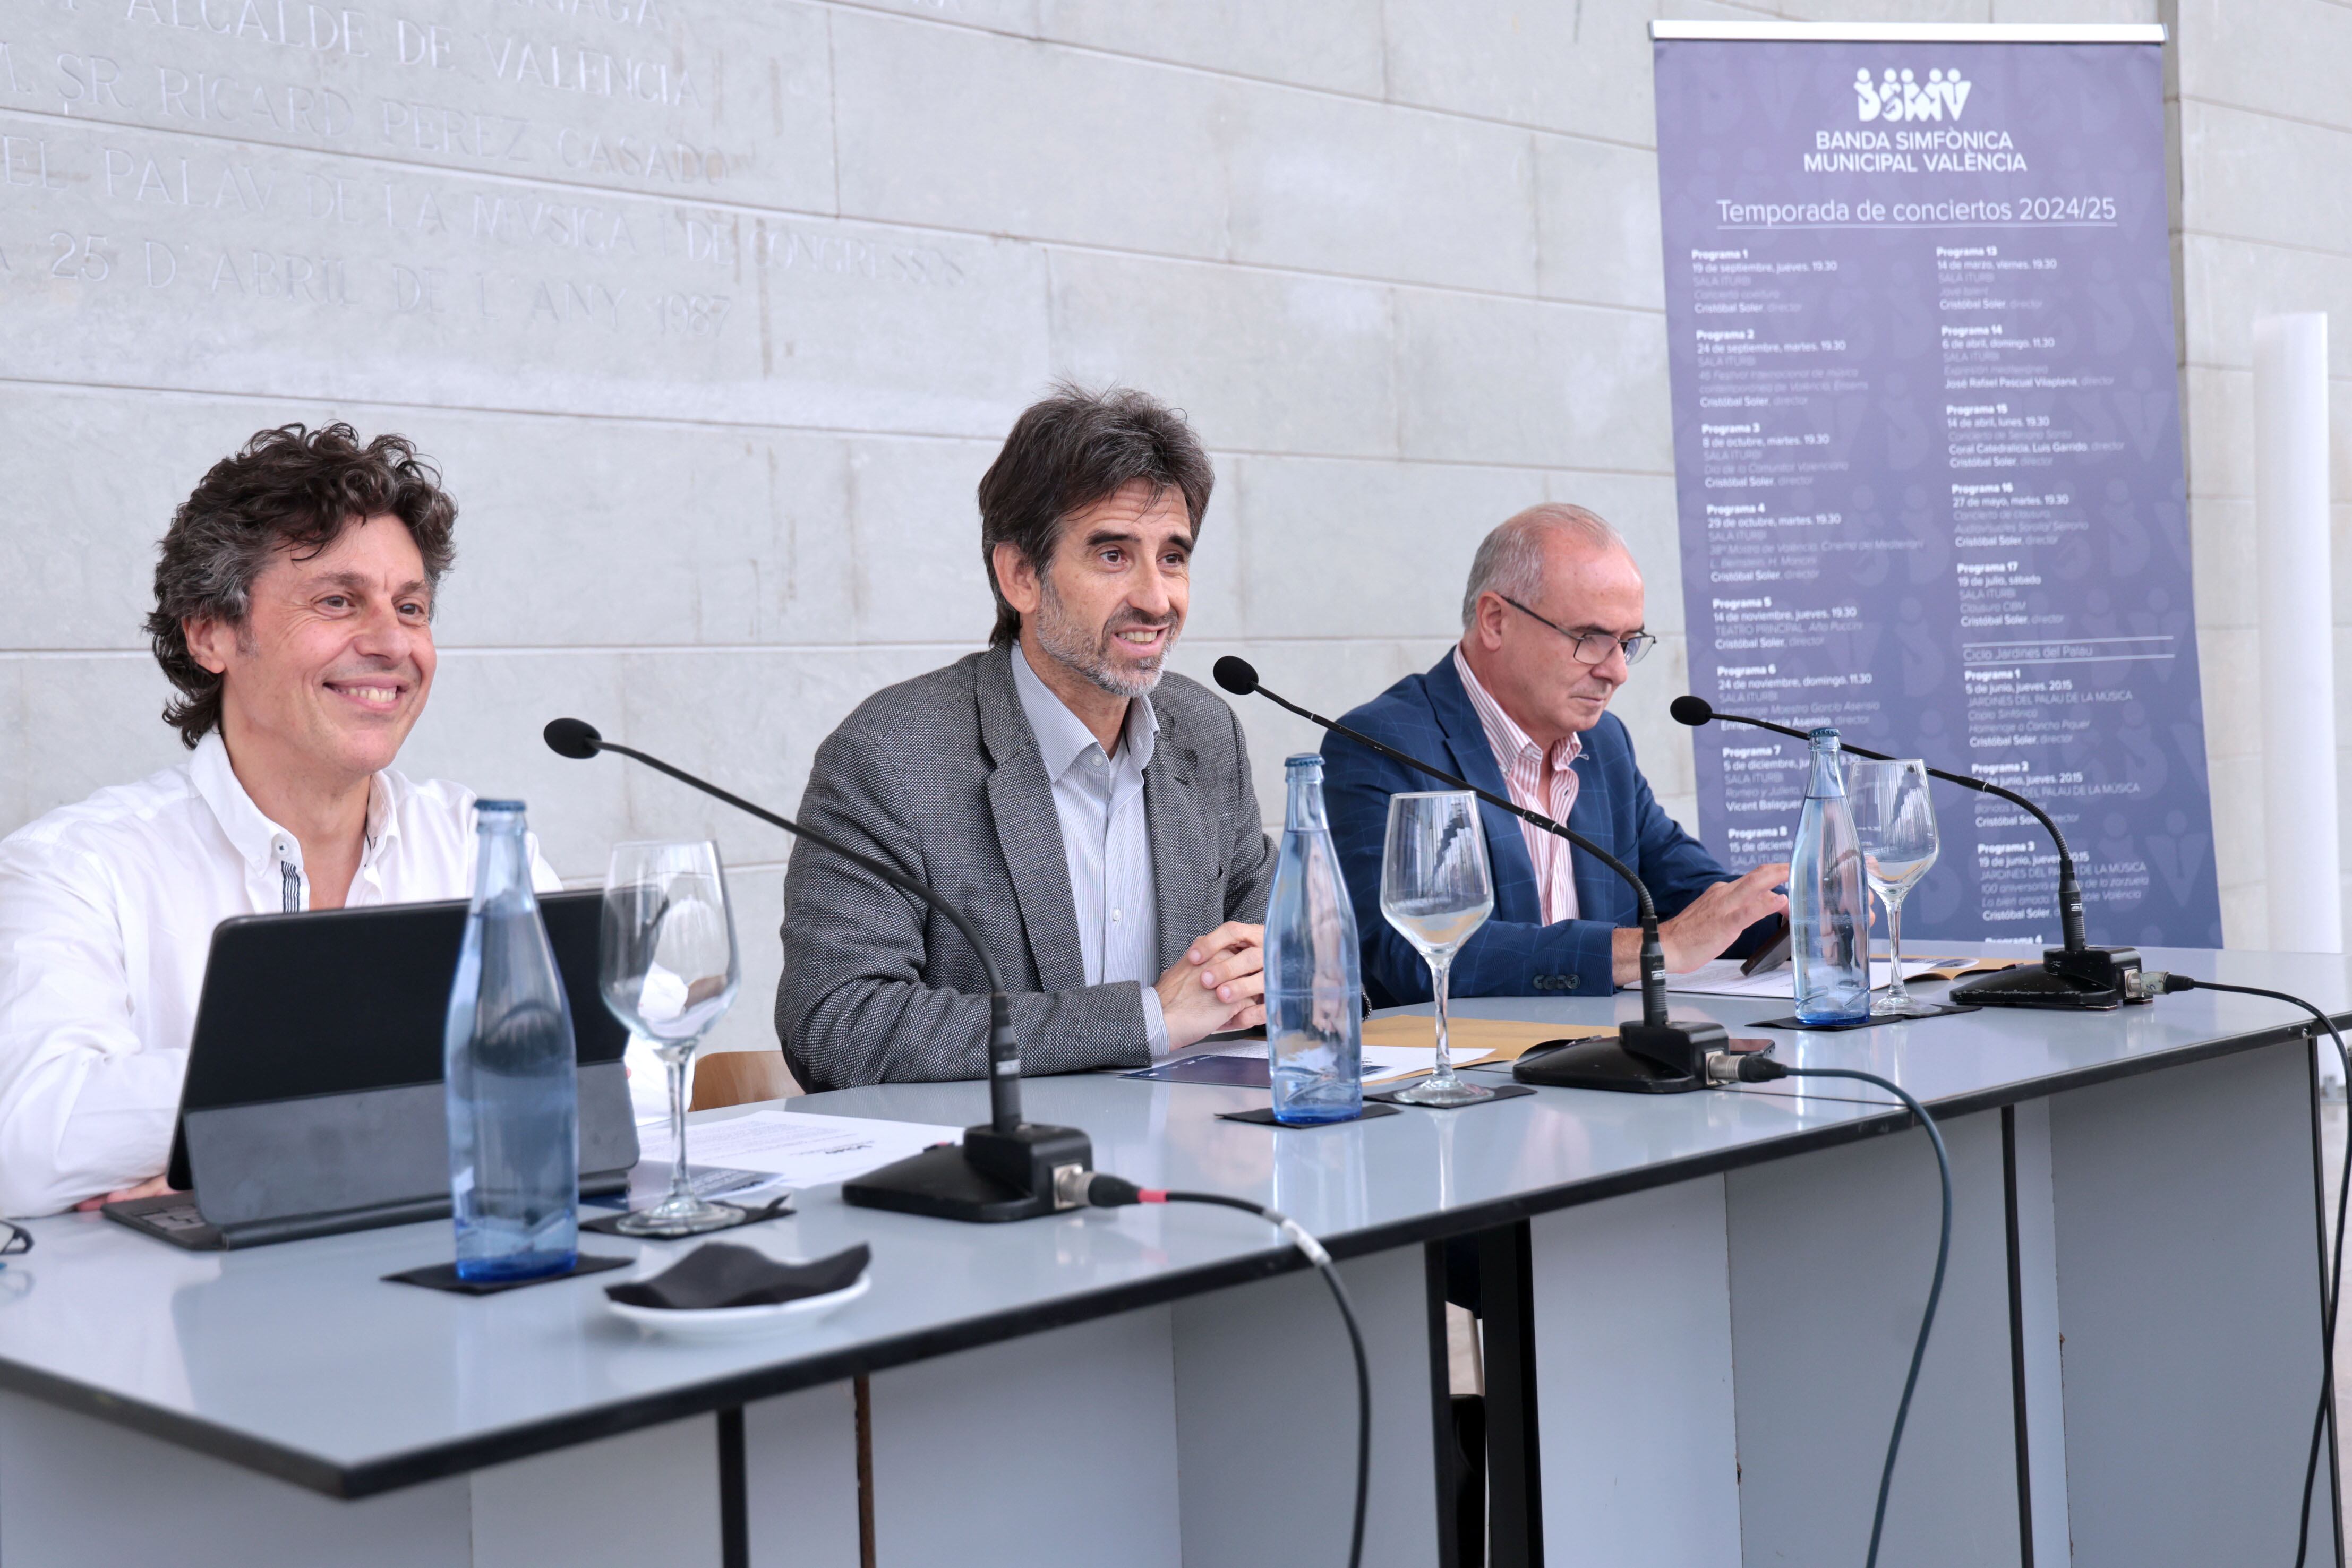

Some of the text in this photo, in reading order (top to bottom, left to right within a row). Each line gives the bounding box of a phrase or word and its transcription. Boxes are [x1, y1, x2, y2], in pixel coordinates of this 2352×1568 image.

[124, 0, 370, 58] ALCALDE
[396, 18, 456, 72] DE
[155, 64, 354, 137] RICARD
[378, 97, 532, 162] PEREZ
[557, 128, 730, 187] CASADO
[1816, 126, 2013, 151] BANDA SIMFÒNICA
[1804, 149, 2028, 172] MUNICIPAL VALÈNCIA
[101, 147, 277, 211] PALAV
[305, 174, 361, 225] DE
[383, 181, 449, 232] LA
[686, 220, 736, 267] DE
[750, 230, 965, 287] CONGRESSOS
[1716, 196, 2116, 227] Temporada de conciertos 2024/25
[1691, 249, 1748, 261] Programa 1
[1936, 246, 1997, 258] Programa 13
[1692, 263, 1703, 273] 19
[1721, 263, 1775, 272] septiembre,
[1776, 263, 1809, 274] jueves.
[1812, 261, 1837, 271] 19.30
[1938, 260, 1947, 269] 14
[1949, 261, 1961, 270] de
[1996, 261, 2030, 270] viernes.
[2033, 258, 2057, 269] 19.30
[49, 230, 109, 282] 25
[392, 262, 448, 315] DE
[654, 292, 731, 337] 1987
[1695, 303, 1737, 314] Cristóbal
[1939, 299, 1981, 310] Cristóbal
[1696, 329, 1754, 341] Programa 2
[1942, 325, 2002, 337] Programa 14
[1697, 340, 1846, 354] 24 de septiembre, martes. 19.30
[1942, 339, 1949, 349] 6
[1951, 339, 1963, 349] de
[1990, 339, 2030, 350] domingo.
[2033, 337, 2055, 348] 11.30
[1945, 379, 1967, 389] José
[1970, 378, 1998, 388] Rafael
[1999, 377, 2033, 388] Pascual
[1700, 397, 1742, 407] Cristóbal
[1946, 404, 2007, 416] Programa 15
[1947, 418, 1957, 427] 14
[1960, 417, 1971, 427] de
[1975, 418, 1996, 427] abril,
[2026, 416, 2049, 426] 19.30
[1701, 423, 1760, 435] Programa 3
[1703, 434, 1829, 448] 8 de octubre, martes. 19.30
[1949, 457, 1991, 468] Cristóbal
[1705, 477, 1747, 488] Cristóbal
[1952, 483, 2013, 495] Programa 16
[1953, 494, 2069, 508] 27 de mayo, martes. 19.30
[1707, 503, 1765, 516] Programa 4
[1708, 513, 1841, 528] 29 de octubre, martes. 19.30
[1955, 537, 1997, 547] Cristóbal
[1957, 561, 2018, 574] Programa 17
[1711, 571, 1754, 582] Cristóbal
[1958, 575, 2041, 587] 19 de julio, sábado
[1713, 597, 1772, 610] Programa 5
[1714, 606, 1857, 622] 14 de noviembre, jueves. 19.30
[1961, 616, 2003, 627] Cristóbal
[1715, 639, 1758, 650] Cristóbal
[1963, 646, 2094, 661] Ciclo Jardines del Palau
[1717, 664, 1776, 678] Programa 6
[1964, 669, 2020, 681] Programa 1
[1718, 673, 1872, 690] 24 de noviembre, domingo. 11.30
[1965, 680, 2072, 695] 5 de junio, jueves. 20.15
[1723, 745, 1781, 759] Programa 7
[1724, 759, 1798, 770] 5 de diciembre,
[1972, 761, 2028, 775] Programa 2
[2059, 772, 2083, 783] 20.15
[1726, 802, 1757, 811] Vicent
[1728, 826, 1787, 839] Programa 8
[1978, 841, 2035, 854] Programa 3
